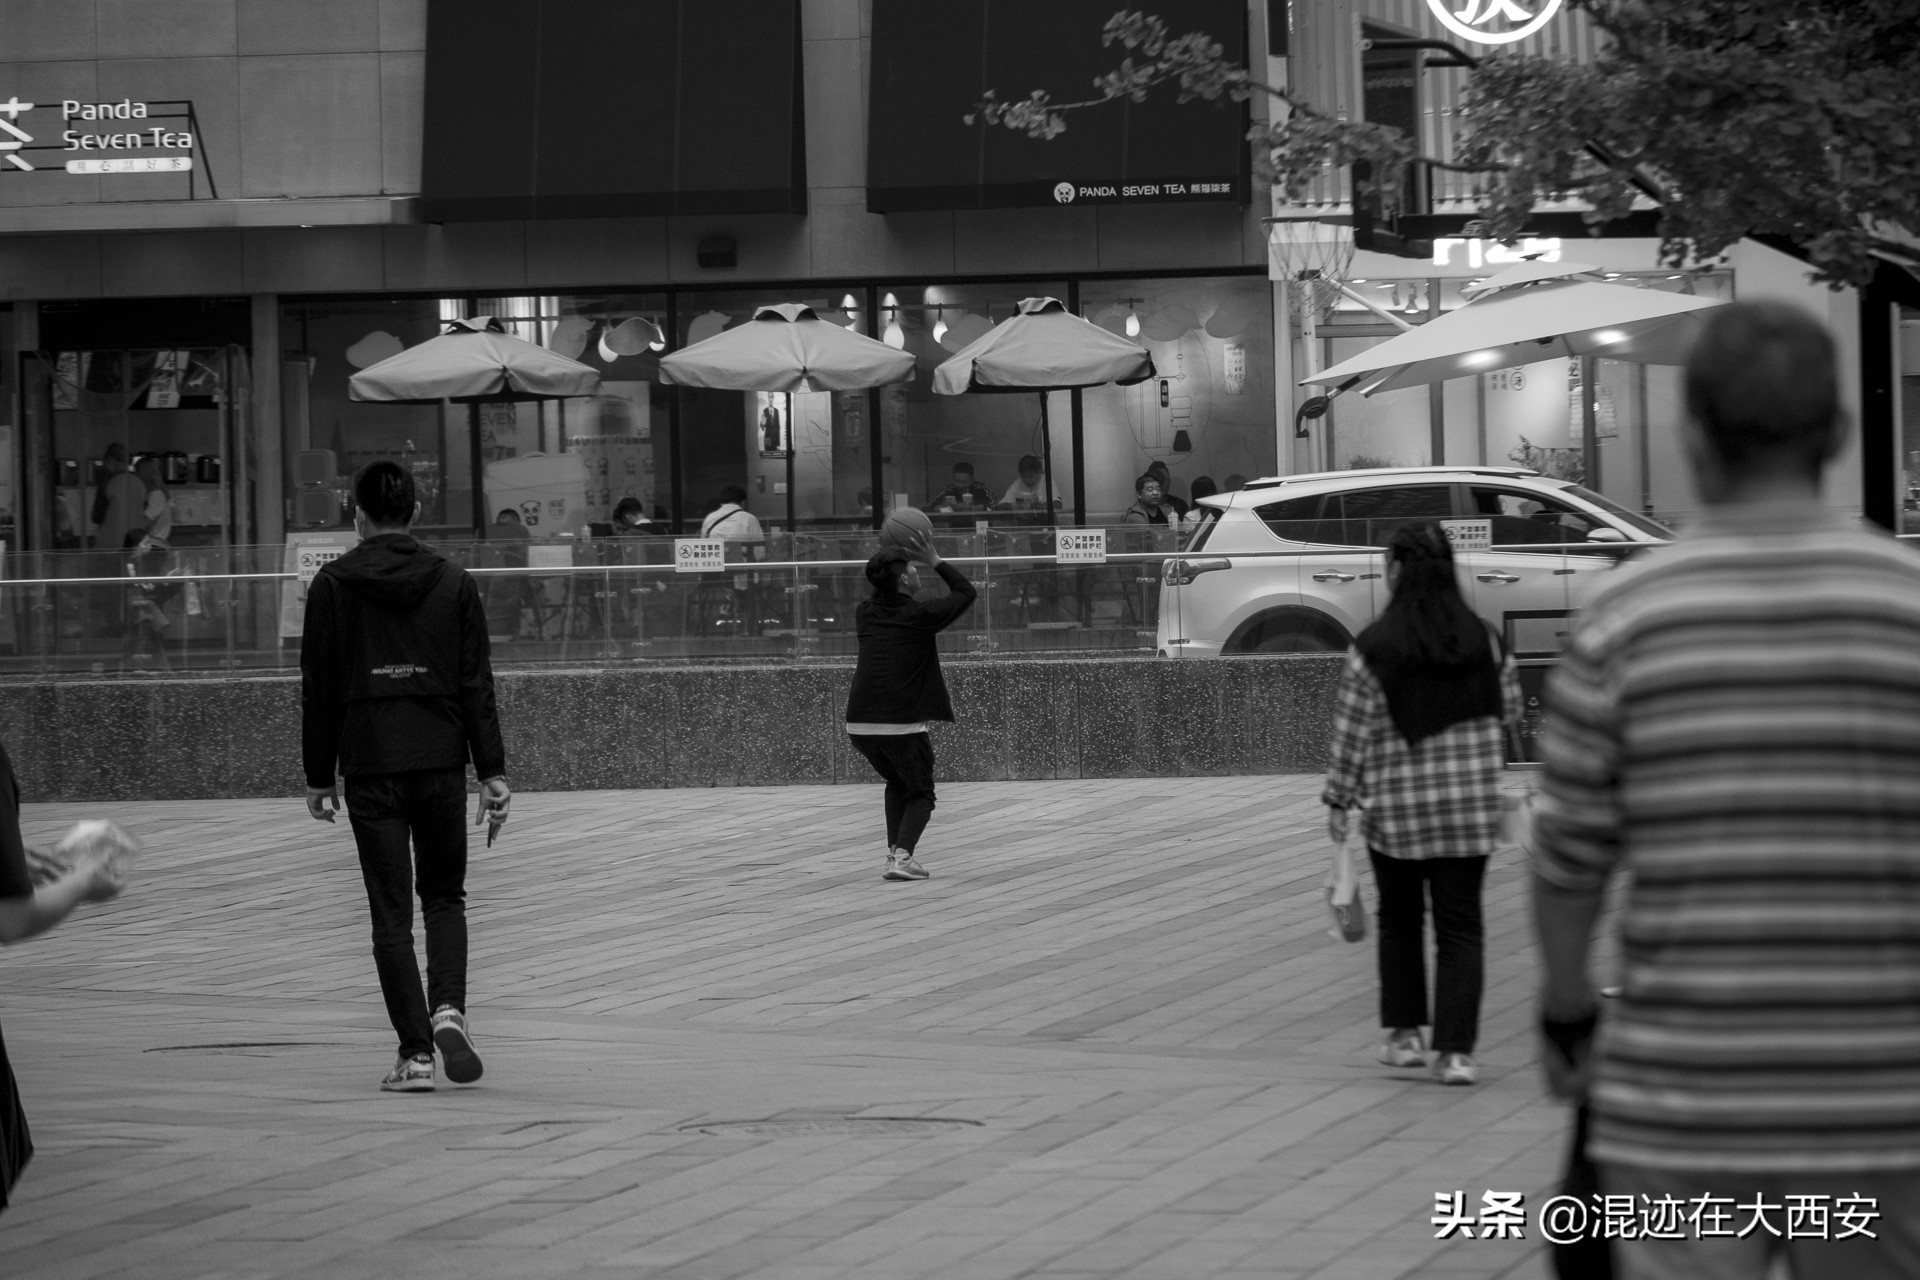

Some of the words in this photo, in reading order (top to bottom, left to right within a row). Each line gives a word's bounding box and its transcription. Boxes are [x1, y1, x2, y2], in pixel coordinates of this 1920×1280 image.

[62, 99, 148, 121] Panda
[62, 130, 142, 151] Seven
[148, 127, 193, 149] Tea
[1079, 186, 1118, 197] PANDA
[1122, 185, 1160, 196] SEVEN
[1163, 184, 1187, 194] TEA
[1075, 535, 1102, 543] 严禁攀爬
[693, 551, 721, 559] 翻越护栏
